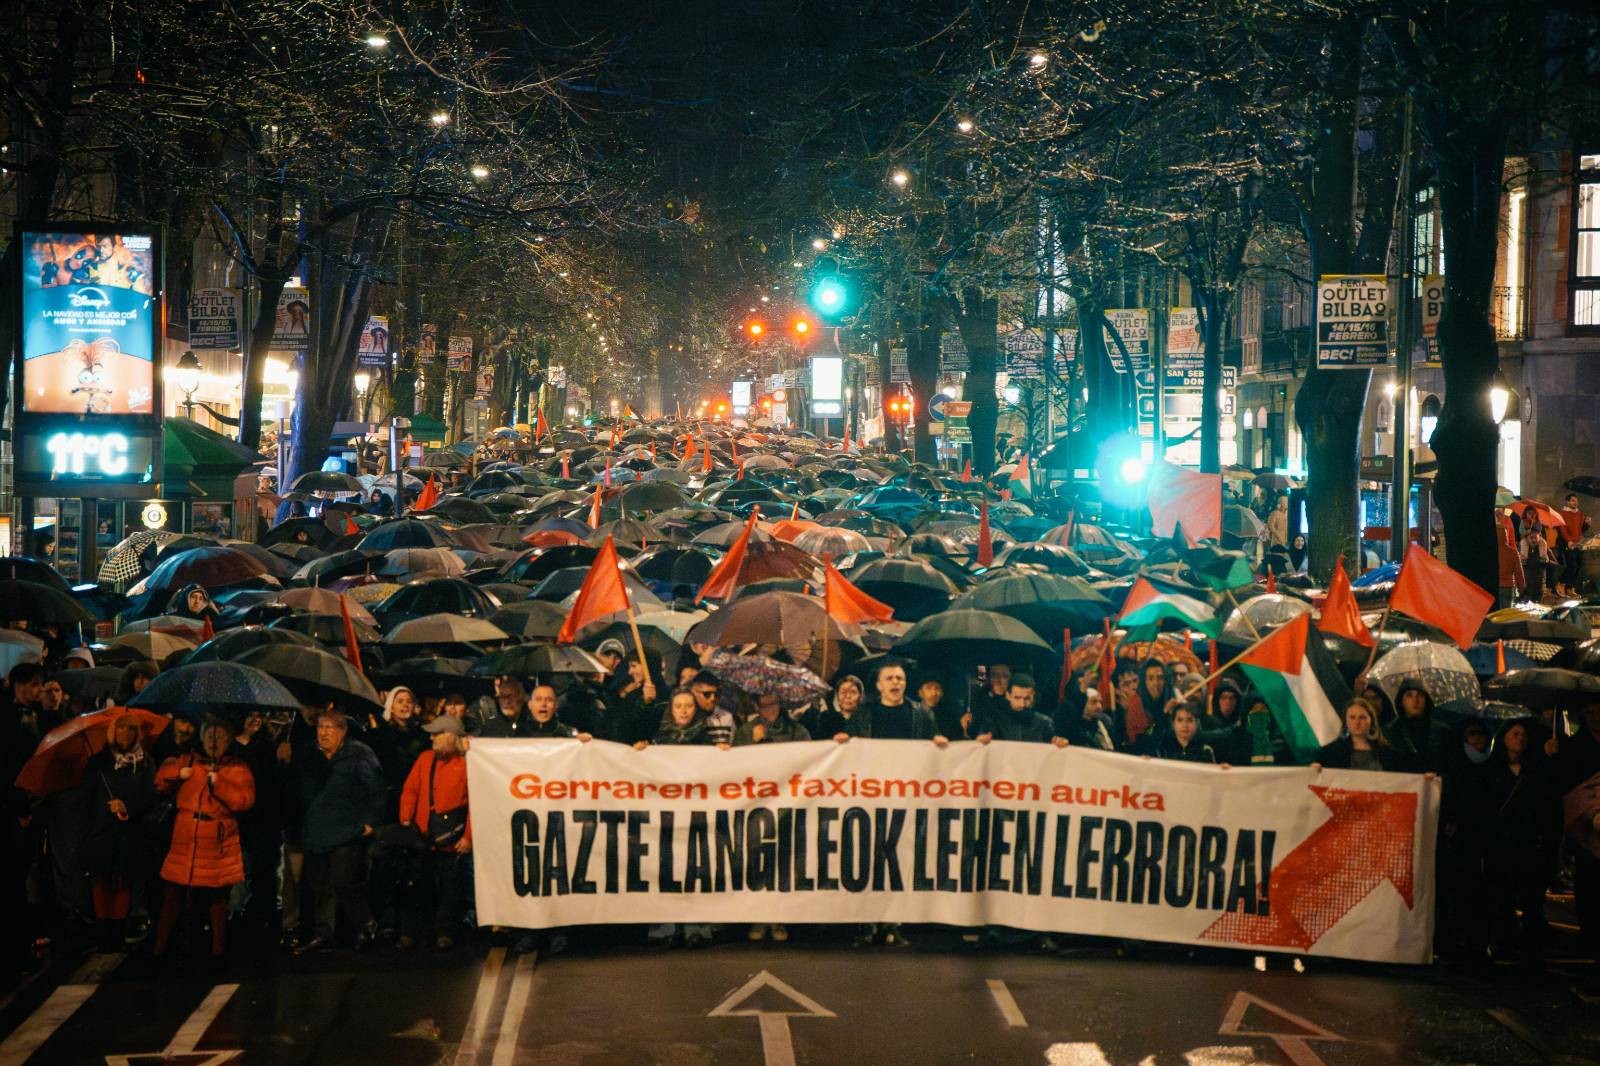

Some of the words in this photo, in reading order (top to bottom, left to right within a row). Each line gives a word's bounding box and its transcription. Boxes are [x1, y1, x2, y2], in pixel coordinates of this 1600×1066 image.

[1323, 288, 1387, 300] OUTLET
[191, 296, 235, 306] OUTLET
[1323, 302, 1386, 317] BILBAO
[1114, 319, 1147, 328] UTLET
[1331, 323, 1376, 332] 14/15/16
[1328, 332, 1377, 341] FEBRERO
[1320, 349, 1354, 360] BEC!
[509, 773, 708, 801] Gerraren
[719, 776, 780, 800] eta
[788, 773, 1041, 802] faxismoaren
[1050, 786, 1166, 812] aurka
[511, 808, 650, 897] GAZTE
[658, 807, 906, 895] LANGILEOK
[913, 807, 1046, 896] LEHEN
[1051, 813, 1277, 917] LERRORA!
